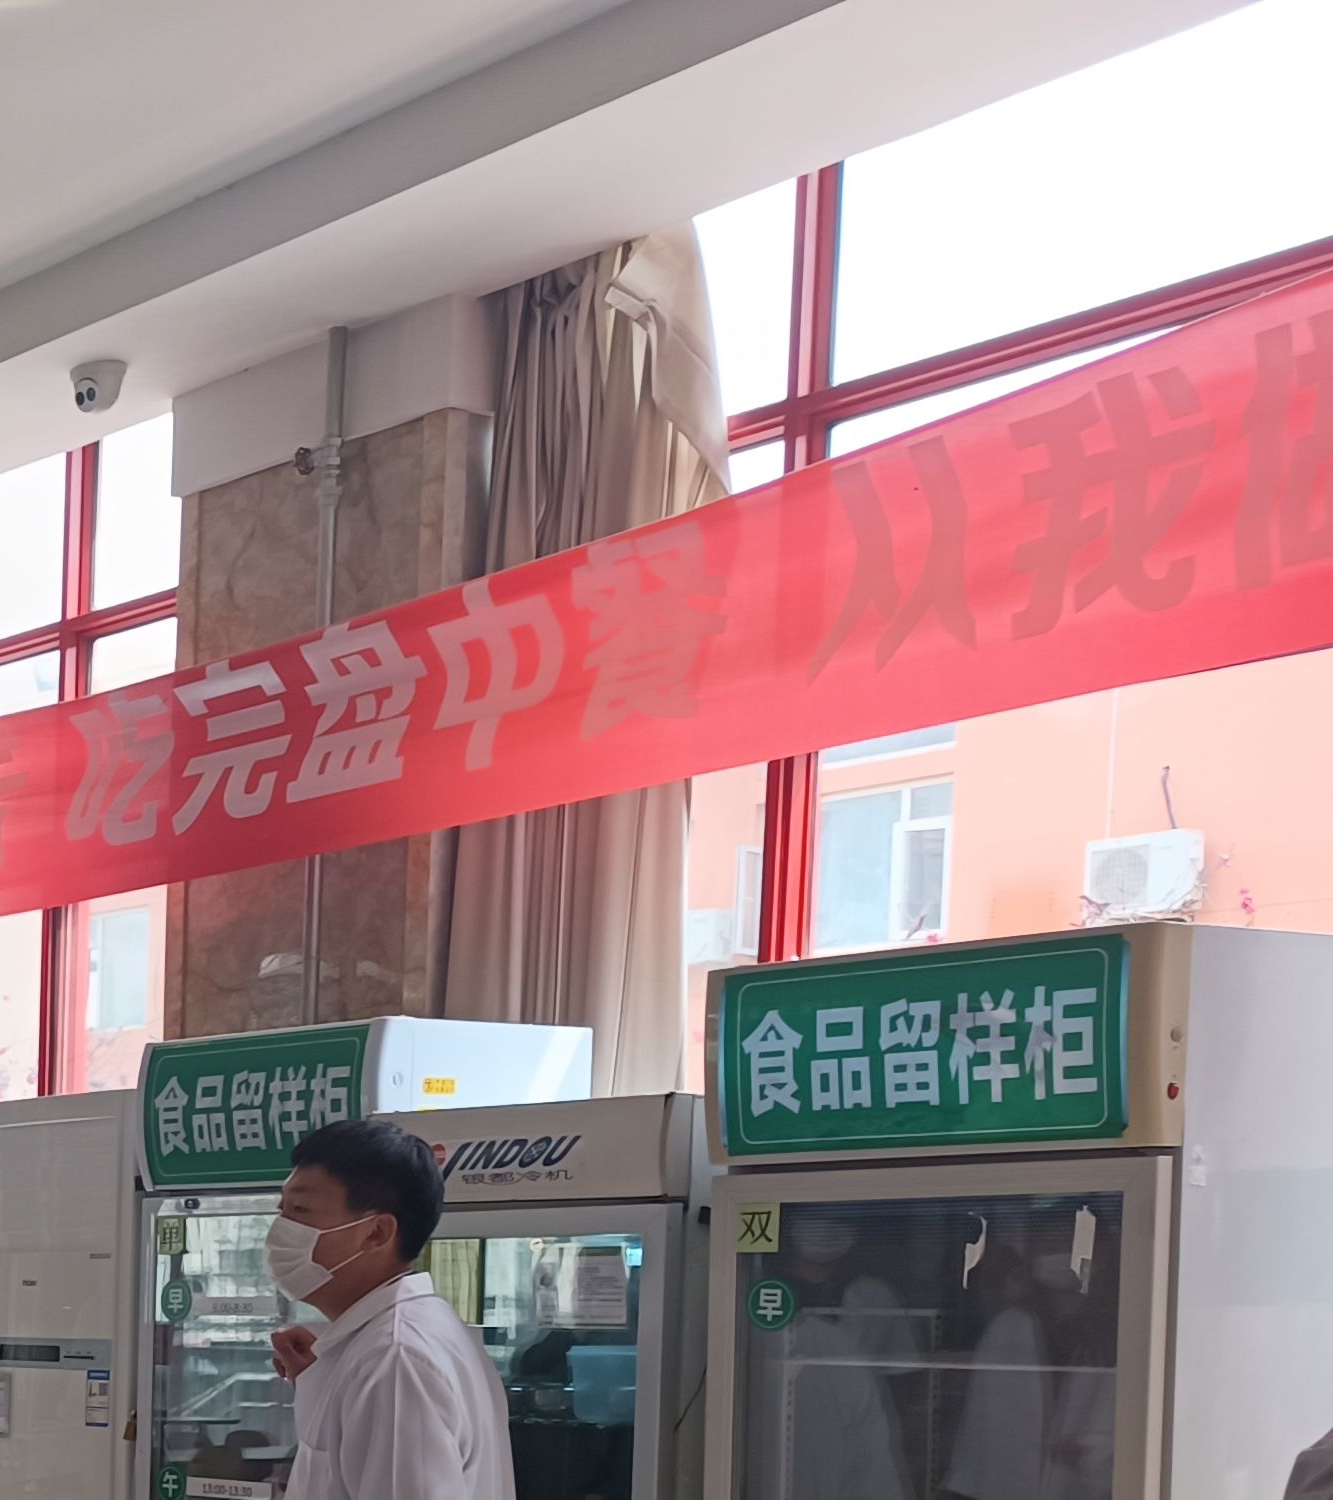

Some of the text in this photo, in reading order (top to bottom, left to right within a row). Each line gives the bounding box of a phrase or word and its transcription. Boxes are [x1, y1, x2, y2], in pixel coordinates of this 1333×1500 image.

[66, 519, 728, 845] 吃完盘中餐
[741, 984, 1098, 1117] 食品留样柜
[153, 1063, 351, 1157] 食品留样柜
[461, 1169, 573, 1186] 银都冷机
[160, 1222, 181, 1251] 单
[738, 1211, 773, 1244] 双
[168, 1288, 184, 1314] 早
[757, 1288, 785, 1322] 早
[162, 1472, 179, 1498] 午
